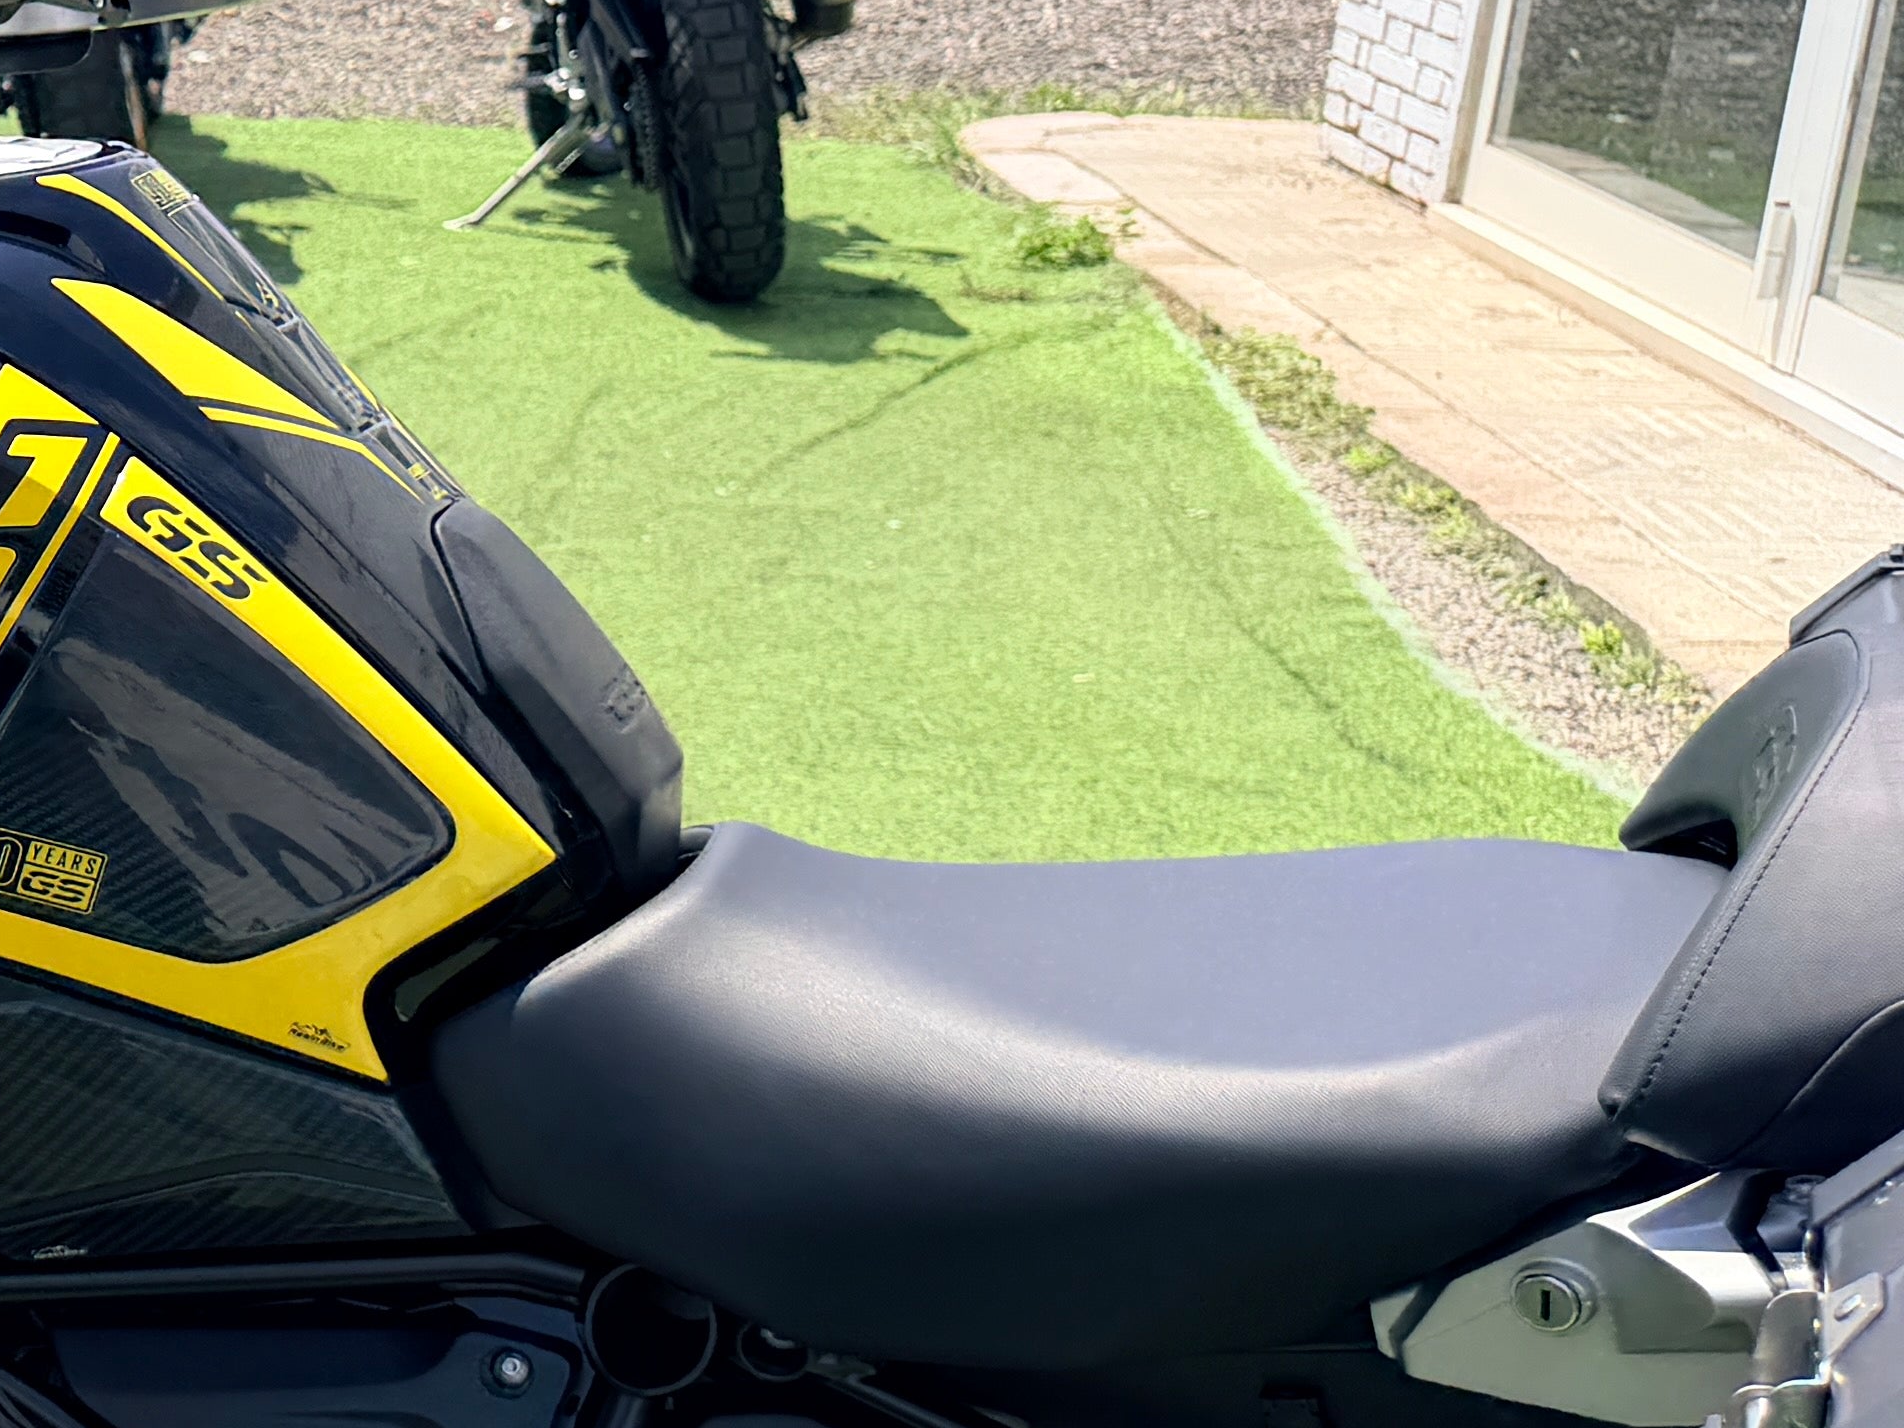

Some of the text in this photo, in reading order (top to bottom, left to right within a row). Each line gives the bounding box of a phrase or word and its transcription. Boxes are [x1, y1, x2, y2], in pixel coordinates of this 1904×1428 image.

[126, 495, 269, 601] GS
[31, 843, 99, 876] YEARS
[20, 869, 92, 903] GS
